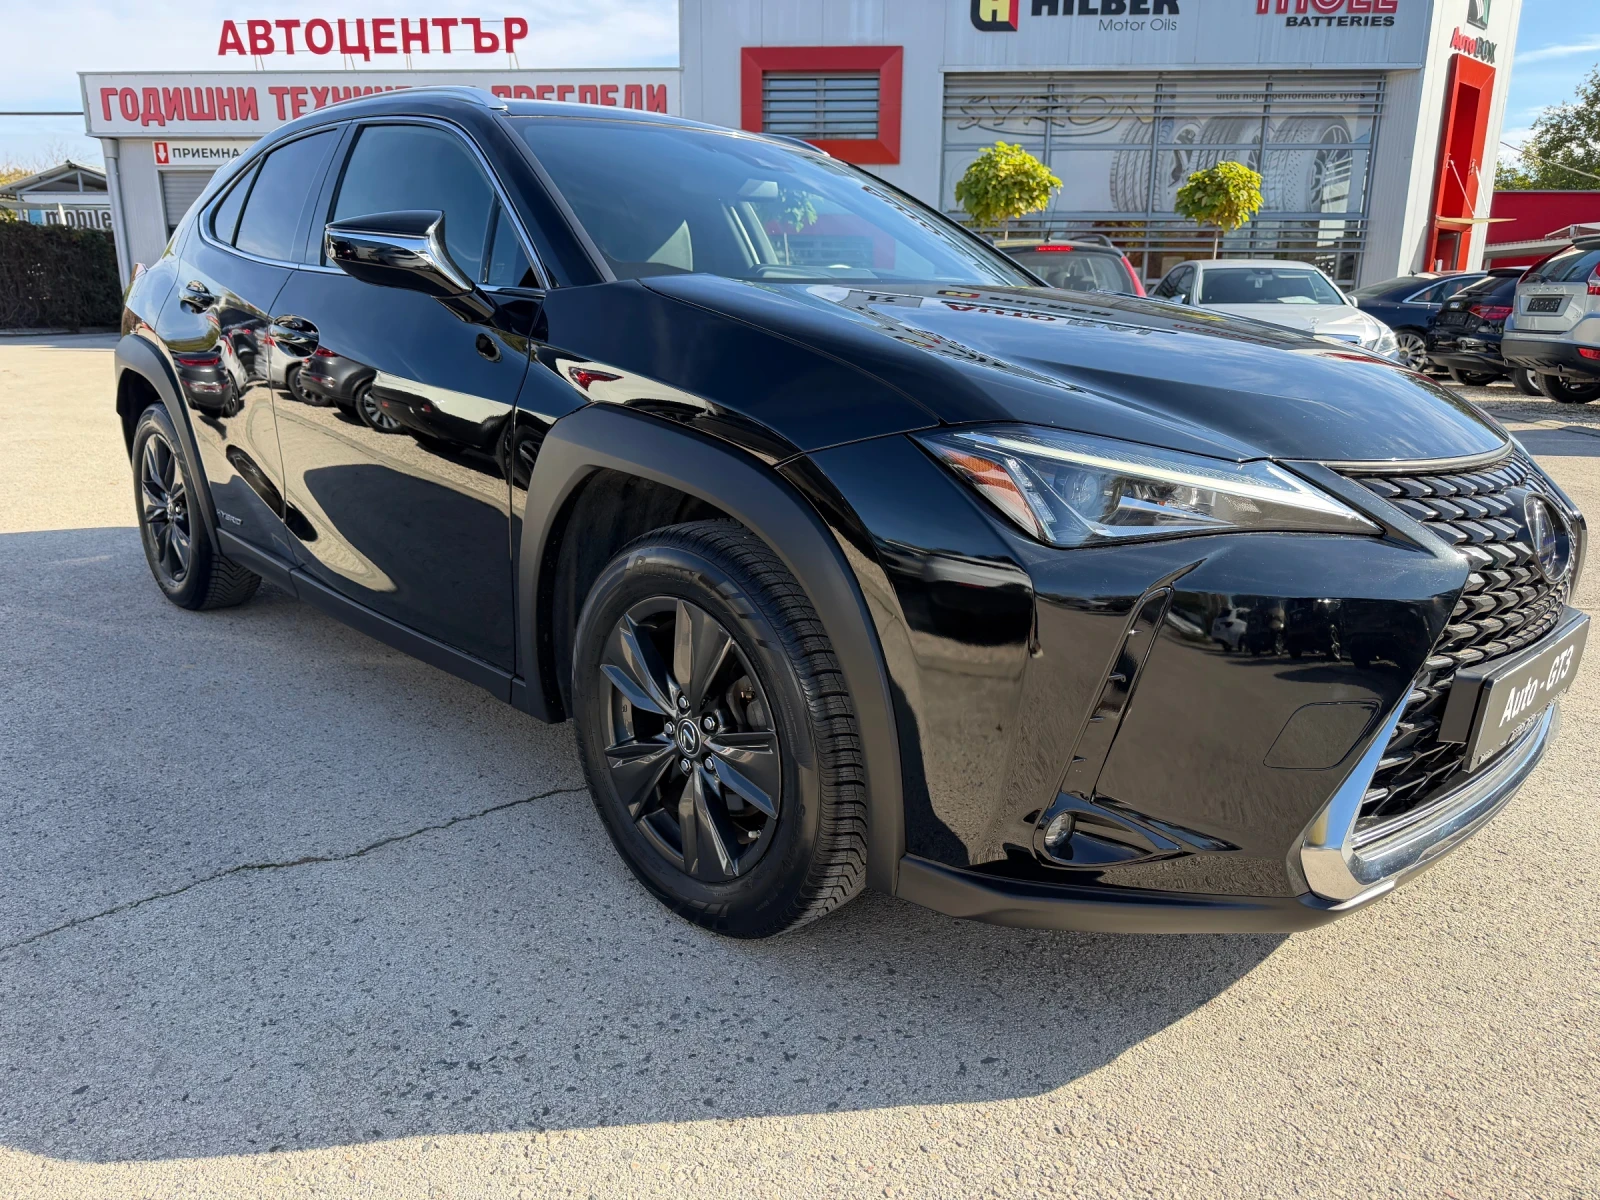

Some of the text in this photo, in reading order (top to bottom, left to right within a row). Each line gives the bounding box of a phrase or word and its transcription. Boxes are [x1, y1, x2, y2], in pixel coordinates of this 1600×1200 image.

[218, 17, 528, 61] АВТОЦЕНТЪР
[1098, 18, 1177, 31] Motor Oils
[1285, 16, 1395, 27] BATTERIES
[100, 86, 259, 127] ГОДИШНИ
[1499, 676, 1538, 728] Auto
[1546, 645, 1574, 691] GT3
